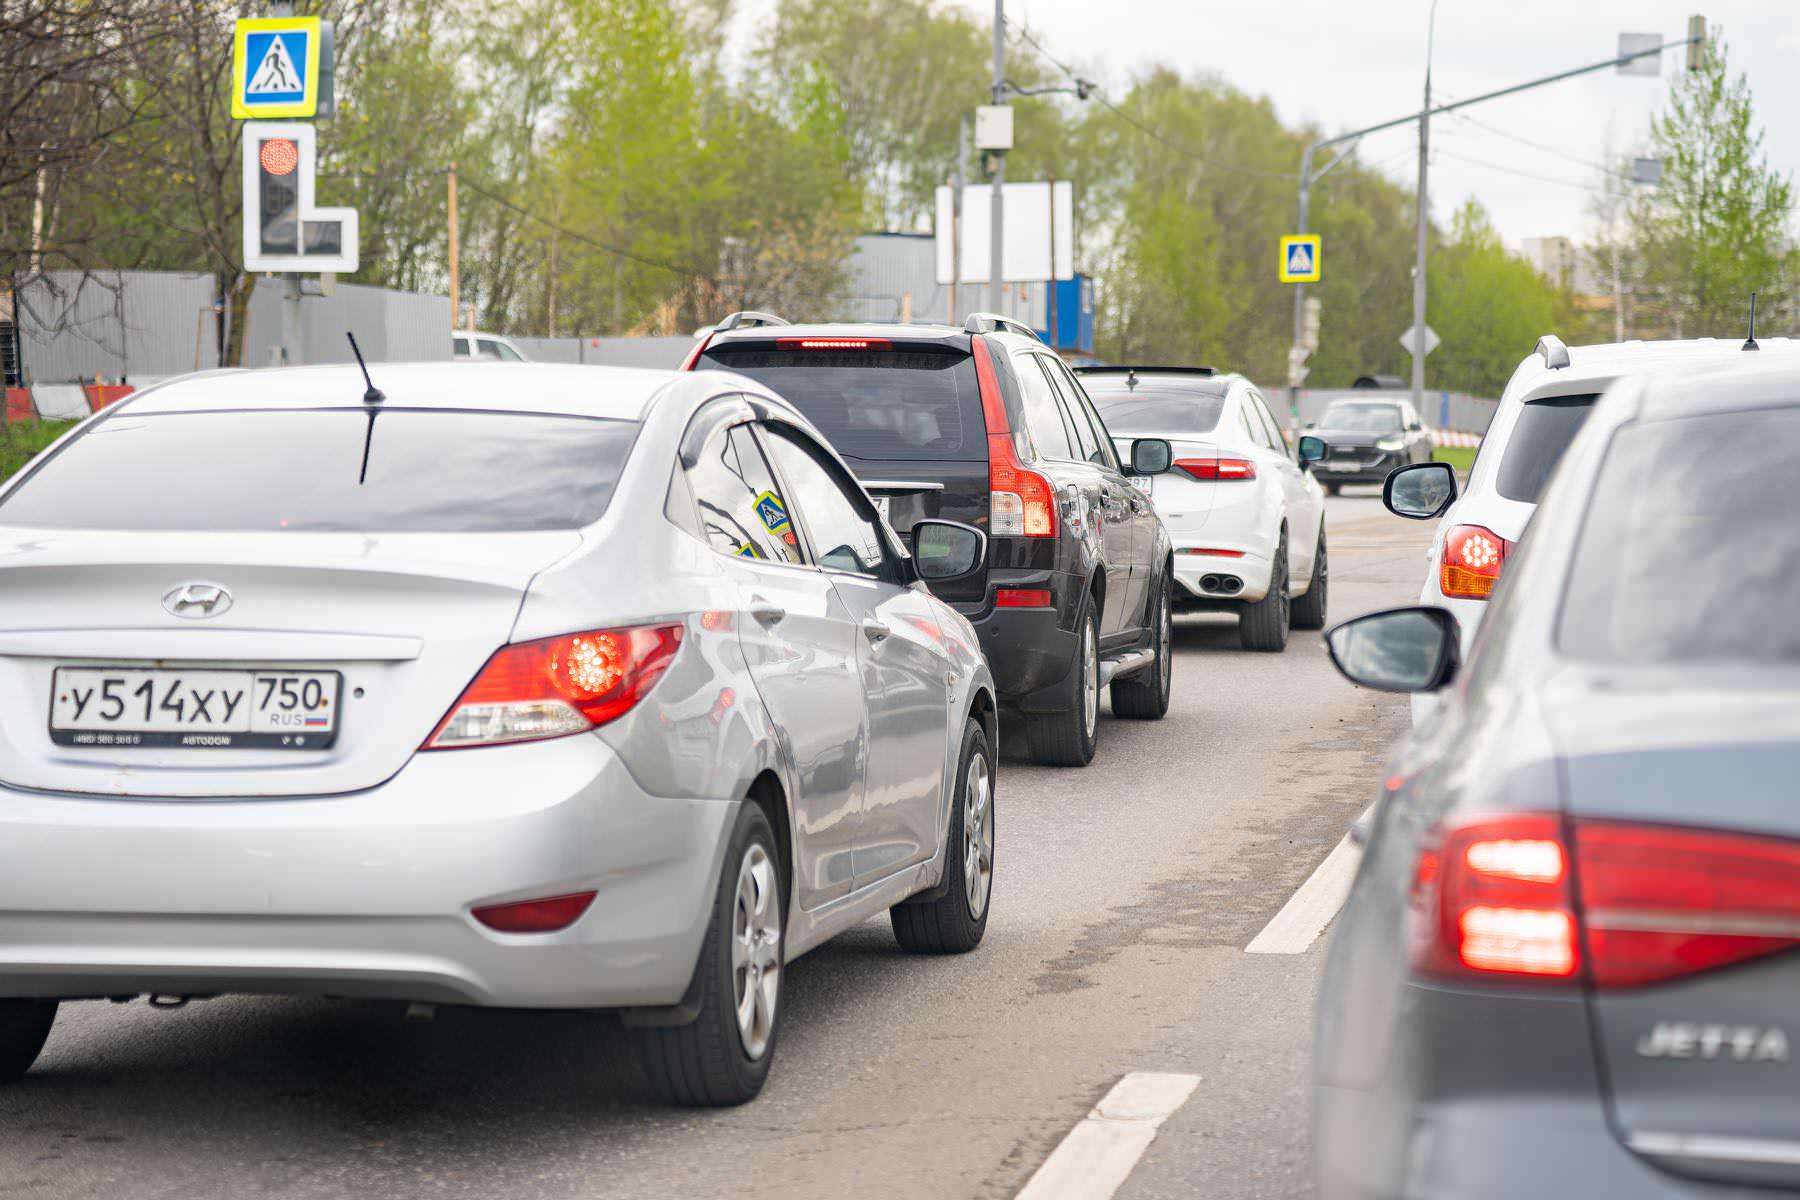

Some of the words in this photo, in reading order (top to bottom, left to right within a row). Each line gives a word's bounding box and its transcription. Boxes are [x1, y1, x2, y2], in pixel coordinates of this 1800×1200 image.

[258, 678, 322, 711] 750
[270, 713, 303, 726] RUS
[1636, 1023, 1790, 1064] JETTA
